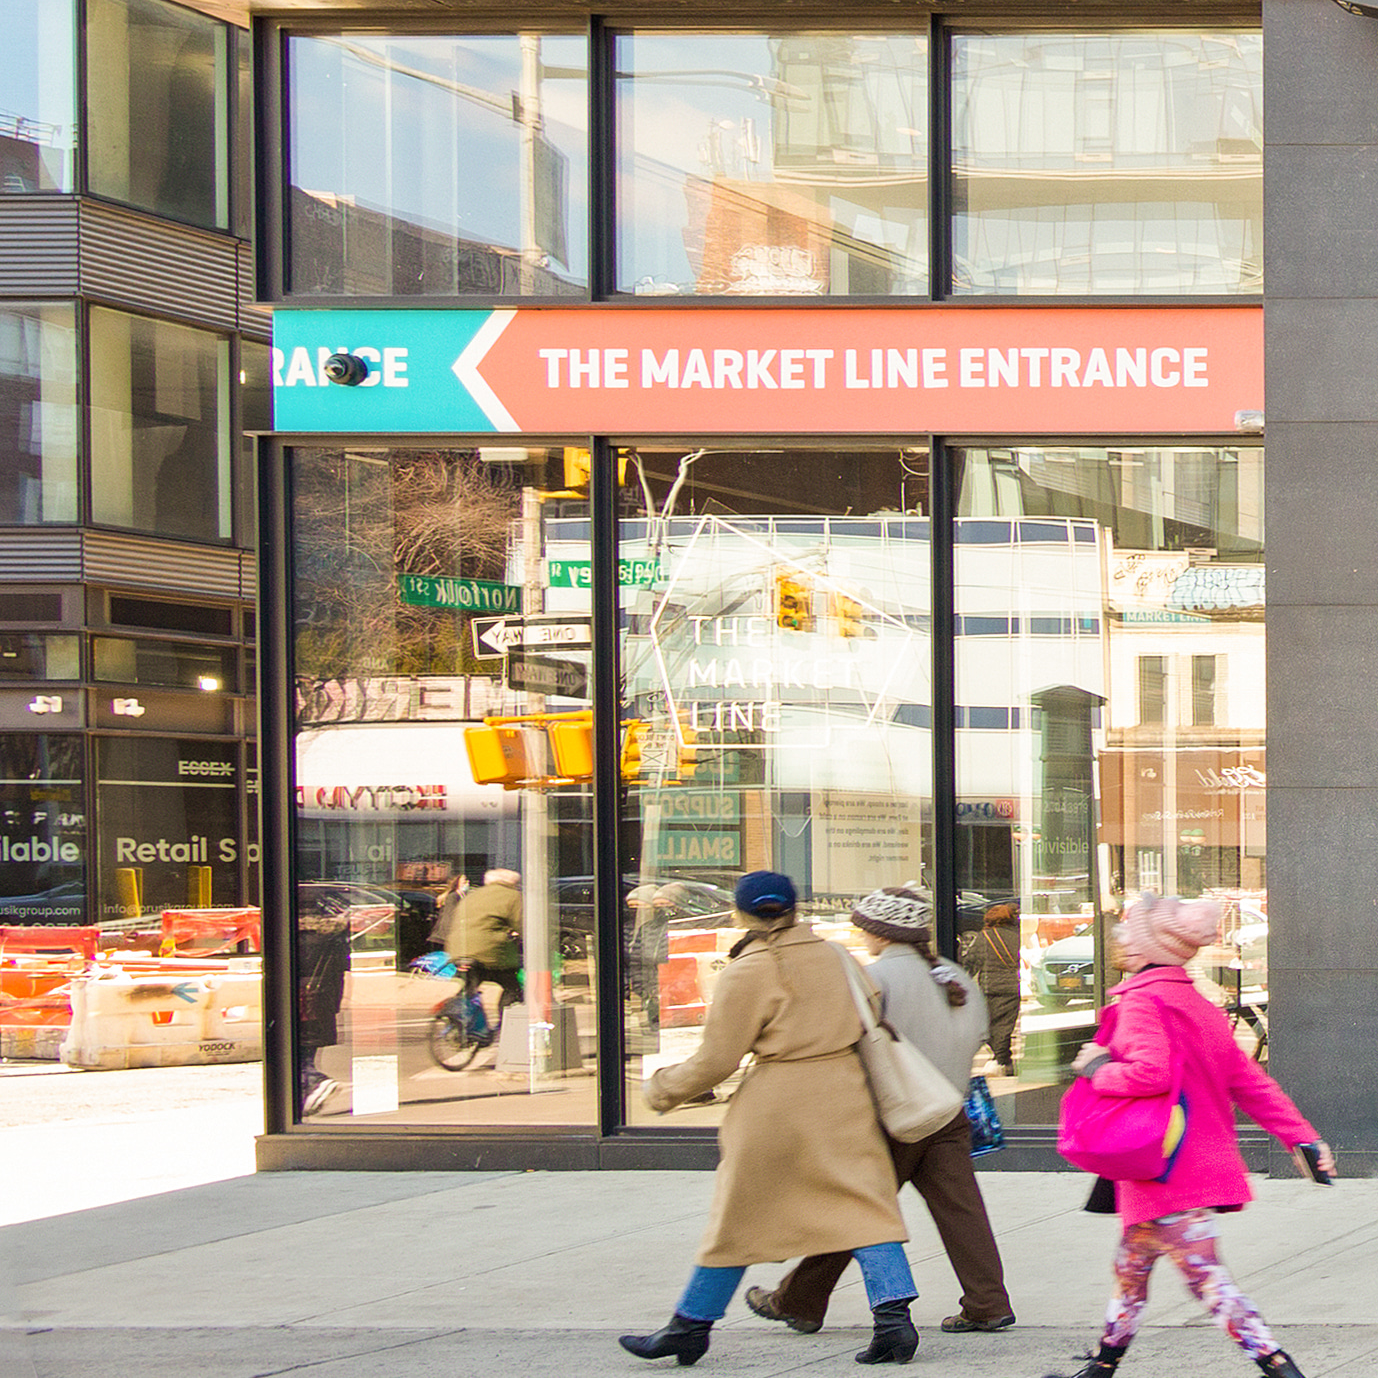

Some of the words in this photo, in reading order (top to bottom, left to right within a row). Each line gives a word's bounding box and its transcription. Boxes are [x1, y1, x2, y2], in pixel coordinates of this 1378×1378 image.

[539, 348, 629, 389] THE
[641, 348, 834, 389] MARKET
[845, 348, 949, 389] LINE
[959, 347, 1209, 389] ENTRANCE
[687, 616, 768, 647] THE
[1125, 611, 1177, 622] MARKET
[689, 658, 856, 689] MARKET
[690, 701, 782, 732] LINE
[178, 760, 236, 776] ESSEX
[0, 834, 80, 863] lable
[116, 835, 208, 863] Retail
